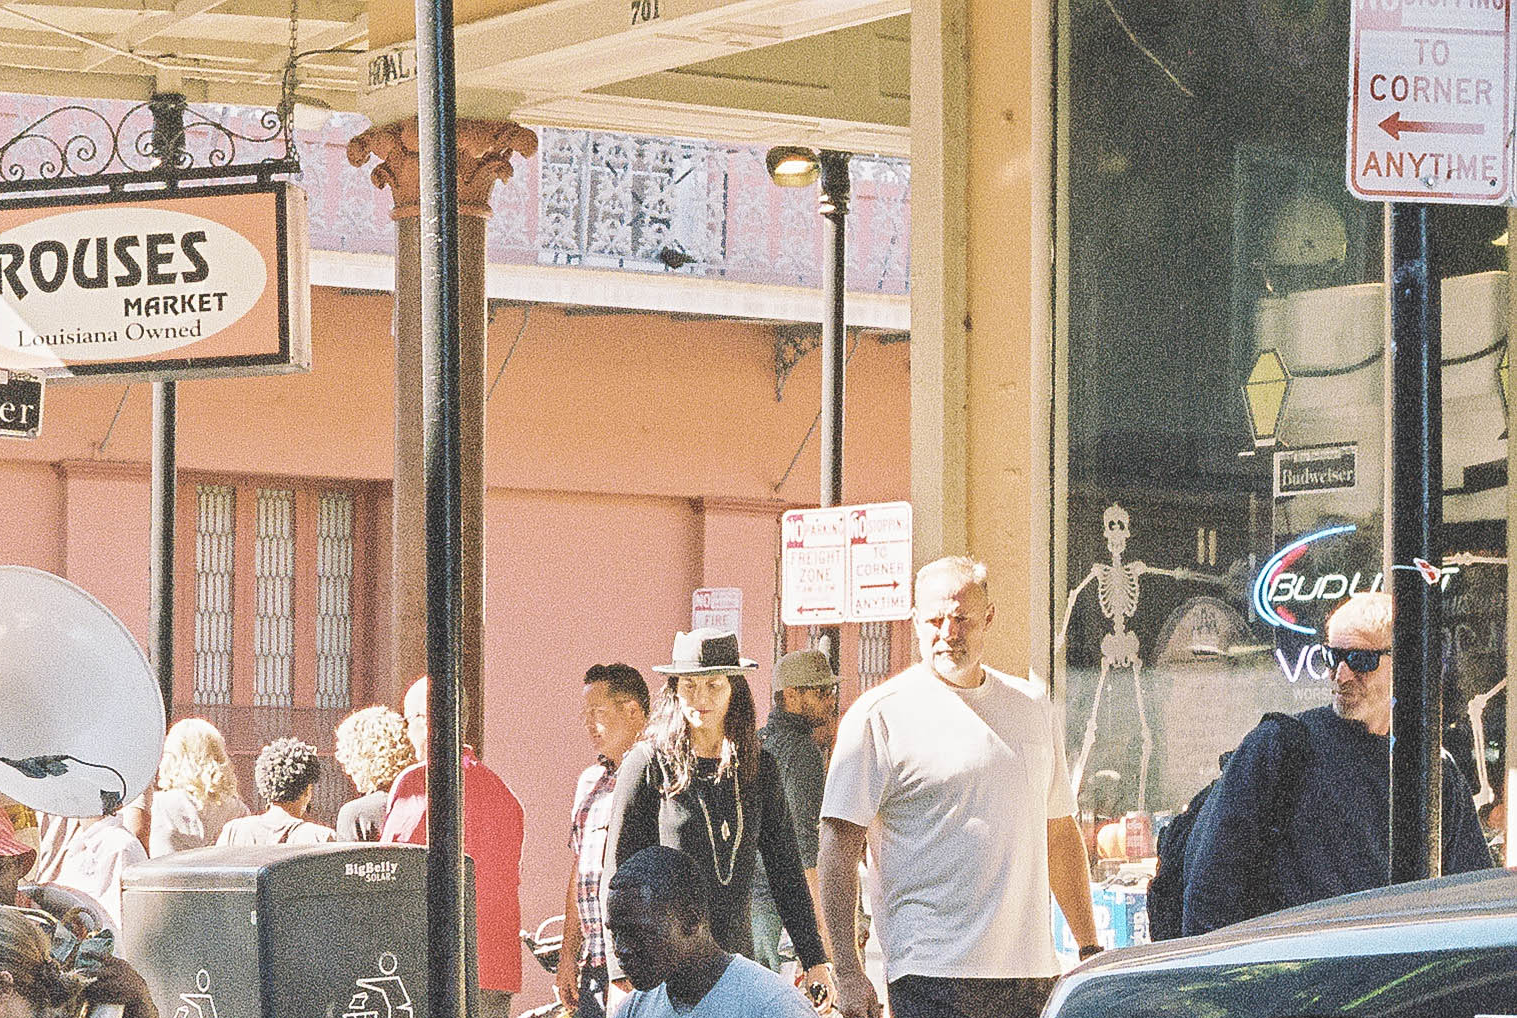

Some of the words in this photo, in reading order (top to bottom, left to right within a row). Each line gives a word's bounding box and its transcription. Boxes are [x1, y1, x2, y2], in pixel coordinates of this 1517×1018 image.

[631, 0, 660, 25] 701
[1414, 39, 1450, 66] TO
[1370, 74, 1492, 105] CORNER
[1362, 151, 1498, 182] ANYTIME
[124, 292, 228, 317] MARKET
[18, 328, 119, 349] Louisiana
[125, 320, 202, 342] Owned
[786, 518, 804, 543] NO
[805, 520, 845, 537] PARKING
[851, 514, 867, 540] NO
[790, 549, 842, 566] FREIGHT
[873, 546, 888, 560] TO
[799, 569, 832, 583] ZONE
[856, 561, 904, 577] CORNER
[855, 595, 907, 610] ANYTIME
[705, 613, 729, 627] FIRE
[345, 861, 398, 876] BigBelly
